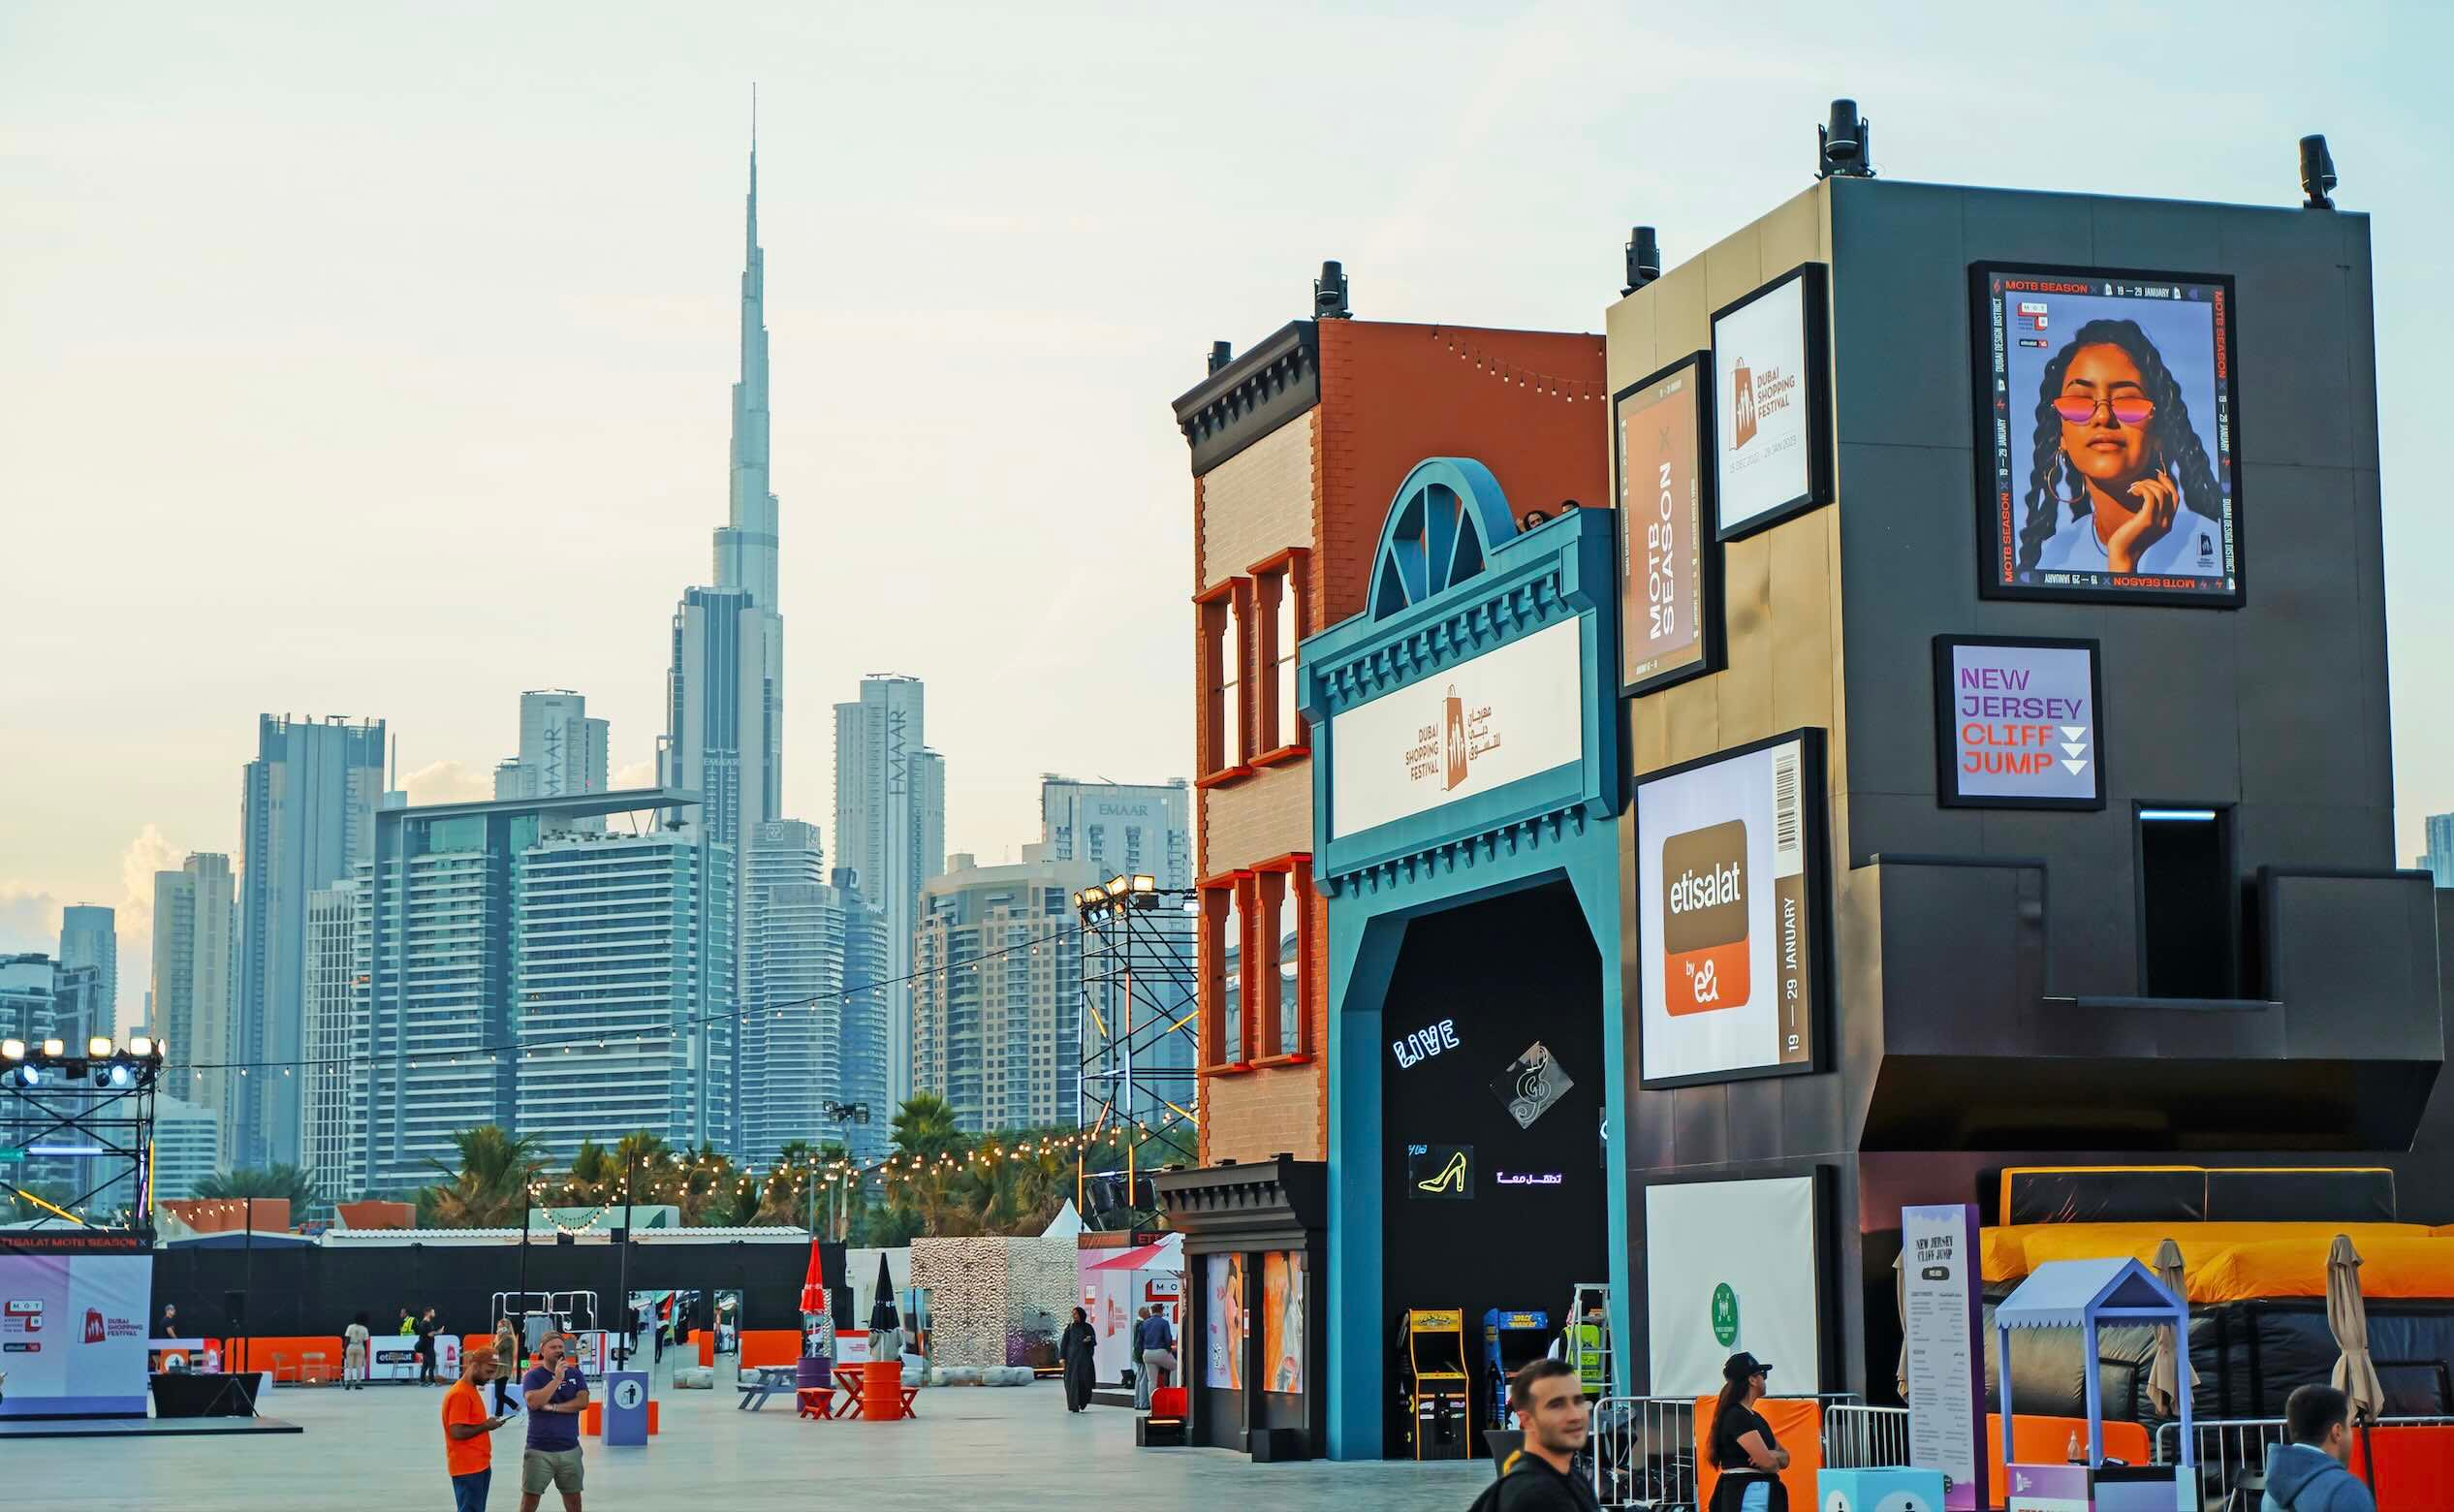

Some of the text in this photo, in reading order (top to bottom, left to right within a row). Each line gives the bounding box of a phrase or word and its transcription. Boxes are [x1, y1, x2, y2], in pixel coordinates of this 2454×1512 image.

[2005, 281, 2088, 294] MOTB SEASON
[2117, 286, 2124, 295] 19
[2134, 287, 2142, 297] 29
[2144, 287, 2169, 298] JANUARY
[1993, 298, 2004, 373] DUBAI DESIGN DISTRICT
[2215, 291, 2226, 379] MOTB SEASON
[1757, 366, 1779, 388] DUBAI
[1757, 375, 1795, 403] SHOPPING
[1758, 394, 1790, 419] FESTIVAL
[2219, 413, 2228, 423] 29
[1998, 418, 2007, 447] JANUARY
[2219, 424, 2229, 452] JANUARY
[1998, 449, 2008, 457] 29
[2000, 492, 2014, 583] MOTB SEASON
[2222, 498, 2235, 574] DUBAI DESIGN DISTRICT
[1659, 461, 1675, 636] SEASON
[1649, 521, 1661, 640] MOTB
[2044, 573, 2070, 583] JANUARY
[2072, 574, 2081, 583] 29
[2091, 575, 2098, 584] 19
[2114, 577, 2195, 588] MOTB SEASON
[1962, 668, 2029, 690] NEW
[1962, 696, 2083, 719] JERSEY
[1419, 723, 1438, 742] DUBAI
[1468, 725, 1488, 740] دبي
[1962, 722, 2054, 747] CLIFF
[544, 727, 561, 796] MAAR
[889, 710, 906, 795] EMAAR
[1405, 741, 1438, 765] SHOPPING
[1963, 751, 2054, 774] JUMP
[1411, 759, 1438, 781] FESTIVAL
[1099, 804, 1148, 815] EMAAR
[1670, 862, 1741, 914] etisalat
[1783, 898, 1797, 969] JANUARY
[1685, 961, 1695, 977] by
[1786, 978, 1799, 999] 29
[1393, 1019, 1460, 1068] LIVE
[1788, 1034, 1800, 1053] 19
[1916, 1236, 1953, 1249] NEW JERSEY
[1918, 1248, 1952, 1262] CLIFF JUMP
